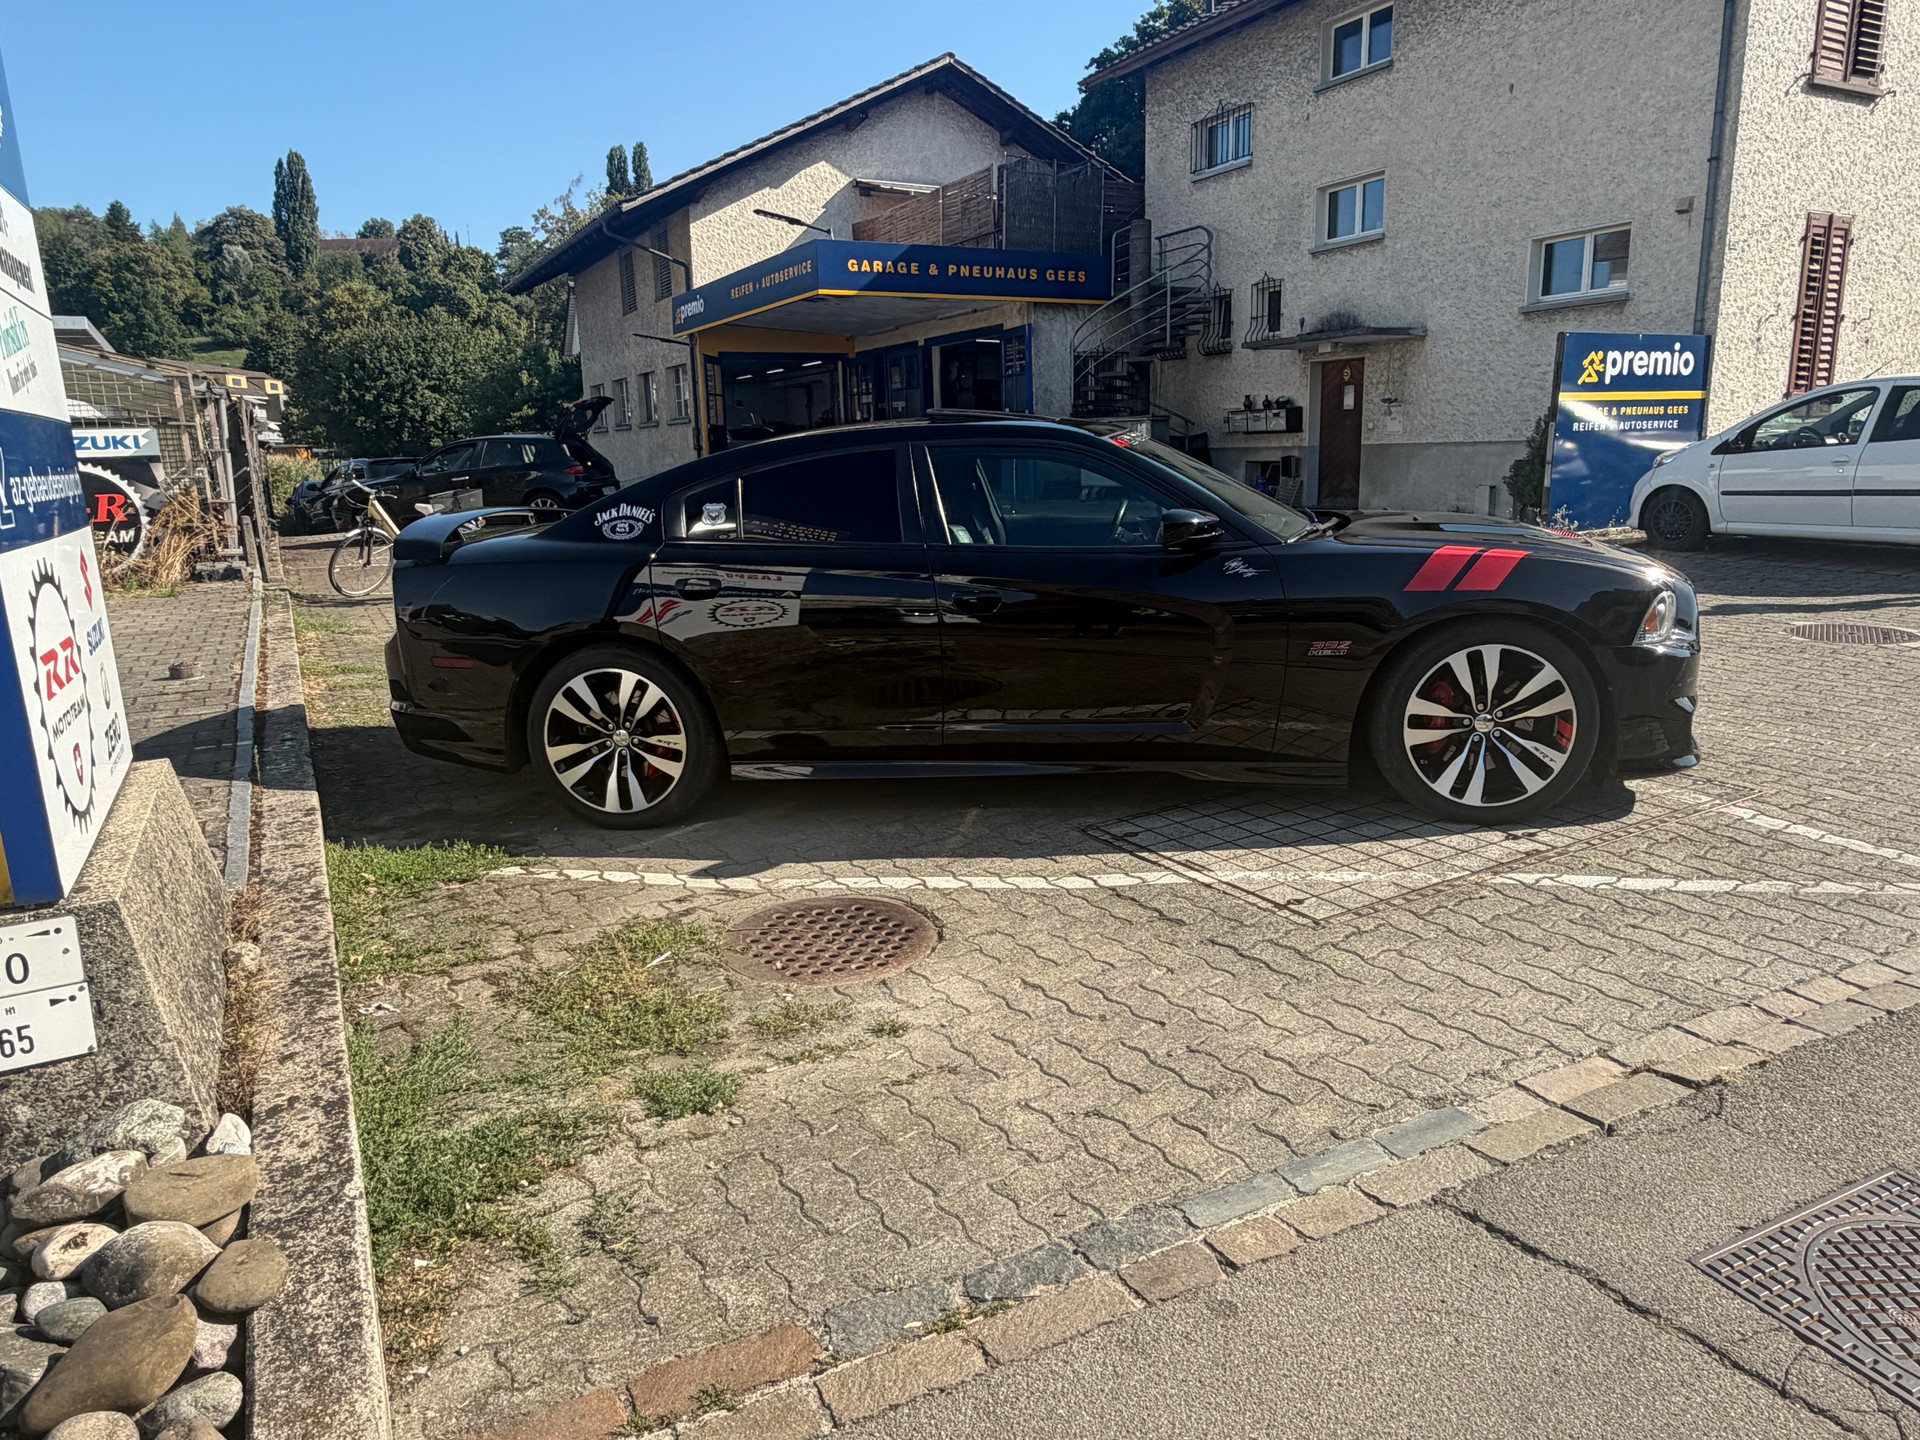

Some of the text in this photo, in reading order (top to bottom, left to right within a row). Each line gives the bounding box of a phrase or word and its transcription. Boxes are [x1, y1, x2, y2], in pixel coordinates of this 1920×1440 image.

[731, 282, 754, 299] REIFEN
[762, 260, 812, 288] AUTOSERVICE
[847, 259, 1086, 282] GARAGE & PNEUHAUS GEES
[680, 294, 705, 325] premio
[1605, 342, 1695, 385] premio
[1620, 406, 1665, 416] PNEUHAUS
[1667, 405, 1689, 415] GEES
[1572, 421, 1606, 432] REIFEN
[1618, 420, 1679, 430] AUTOSERVICE
[594, 503, 656, 527] JACK DANIEL'S
[1310, 640, 1353, 650] 392
[52, 693, 87, 743] MOTOTEAM
[105, 712, 122, 761] ZERO
[1530, 745, 1557, 763] SRT
[5, 1006, 16, 1017] H1
[0, 1024, 35, 1059] 65
